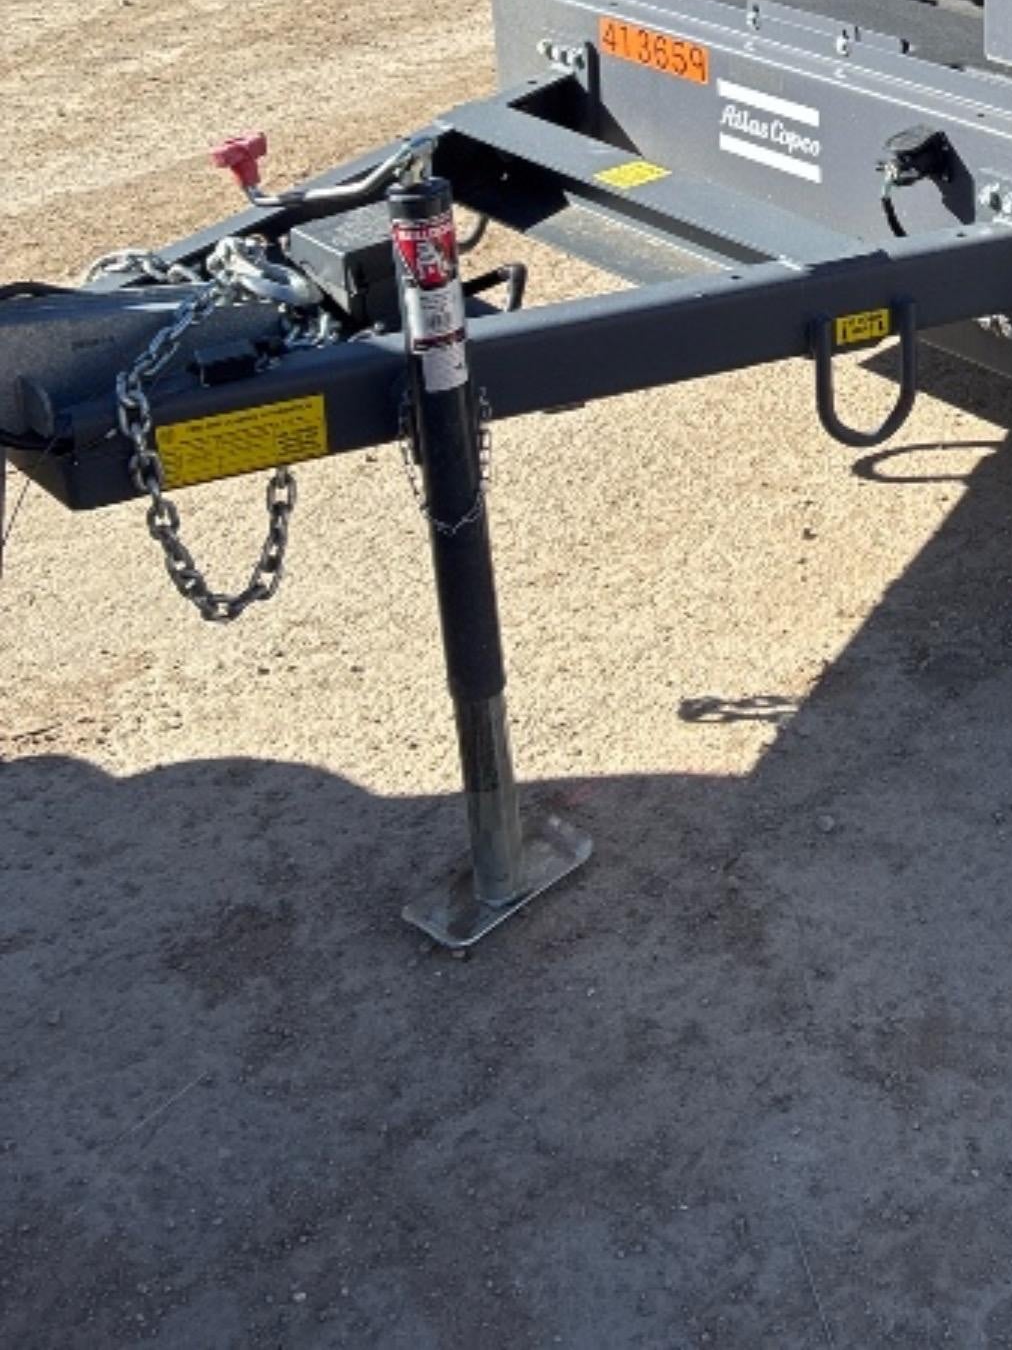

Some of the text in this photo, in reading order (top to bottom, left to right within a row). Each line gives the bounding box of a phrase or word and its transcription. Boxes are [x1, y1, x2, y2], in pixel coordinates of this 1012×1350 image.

[601, 22, 707, 82] 413659
[718, 103, 820, 157] Atlas Copco
